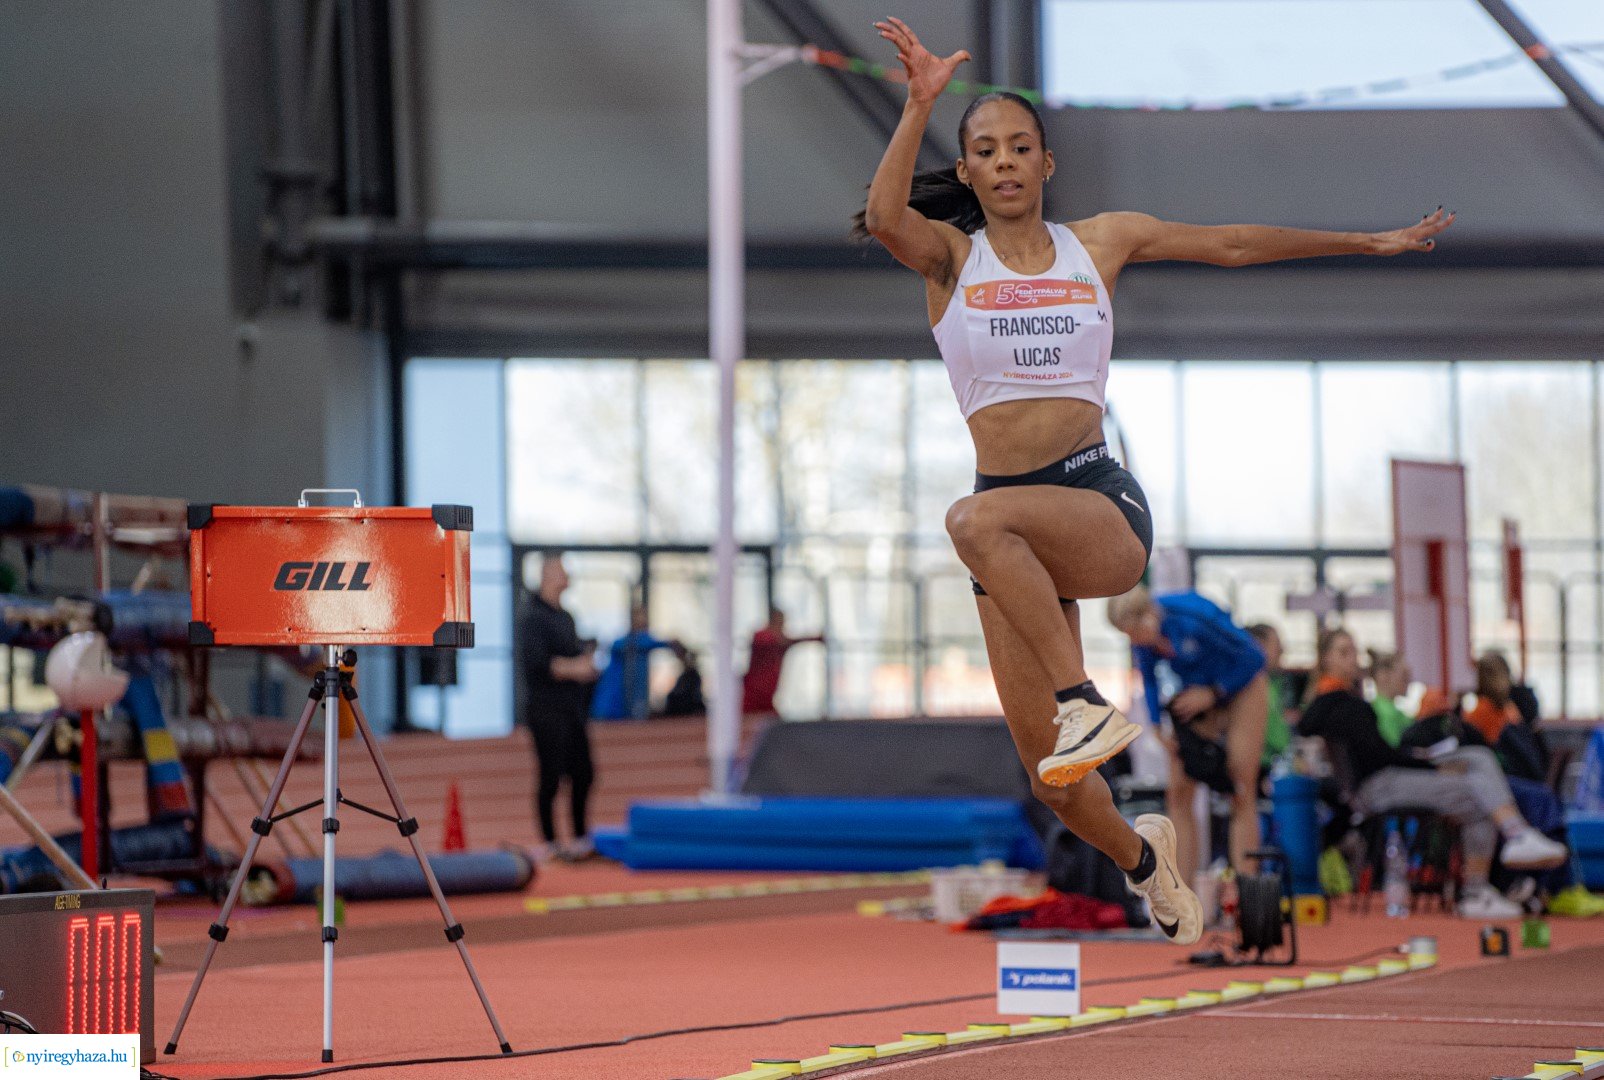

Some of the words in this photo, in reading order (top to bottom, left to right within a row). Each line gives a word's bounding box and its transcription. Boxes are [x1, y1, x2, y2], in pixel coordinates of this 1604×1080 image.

[990, 315, 1081, 337] FRANCISCO-
[1013, 347, 1061, 367] LUCAS
[1064, 448, 1099, 474] NIKE
[273, 561, 371, 591] GILL
